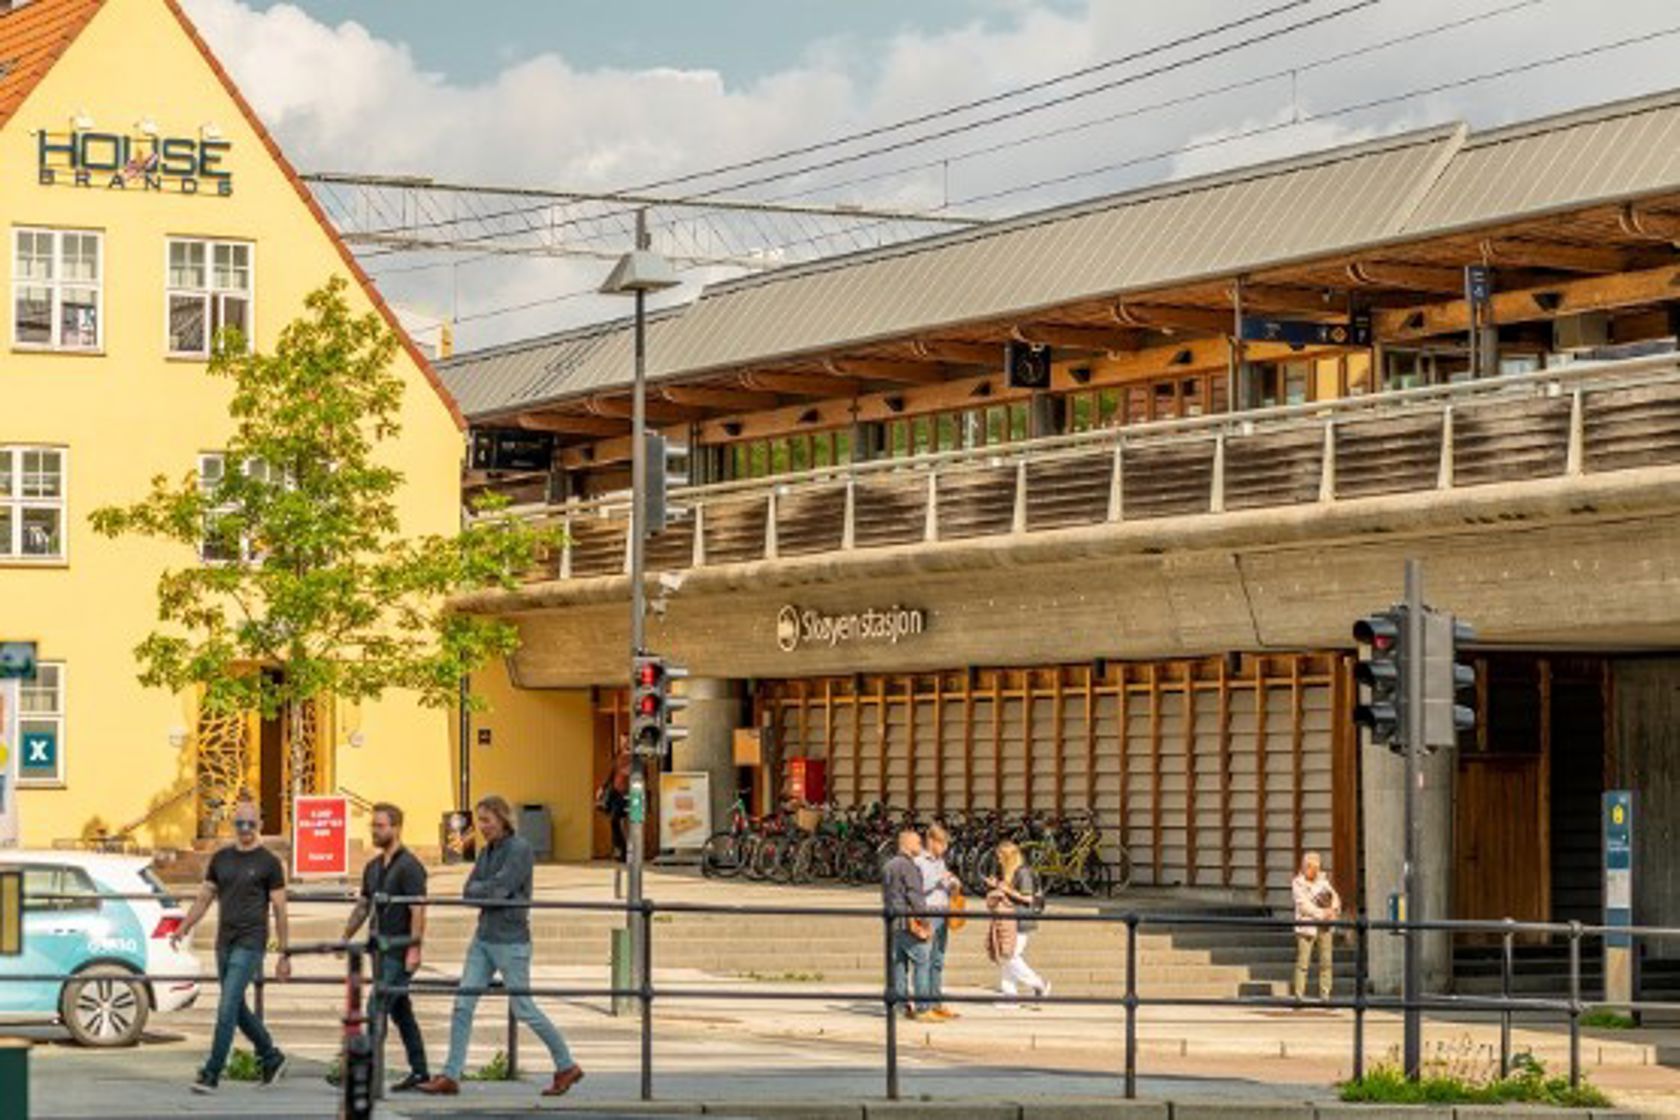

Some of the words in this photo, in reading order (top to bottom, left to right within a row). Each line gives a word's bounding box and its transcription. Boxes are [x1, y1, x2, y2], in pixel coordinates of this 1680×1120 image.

[38, 129, 232, 178] HOUSE
[38, 169, 232, 197] BRANDS
[862, 604, 921, 643] stasjon
